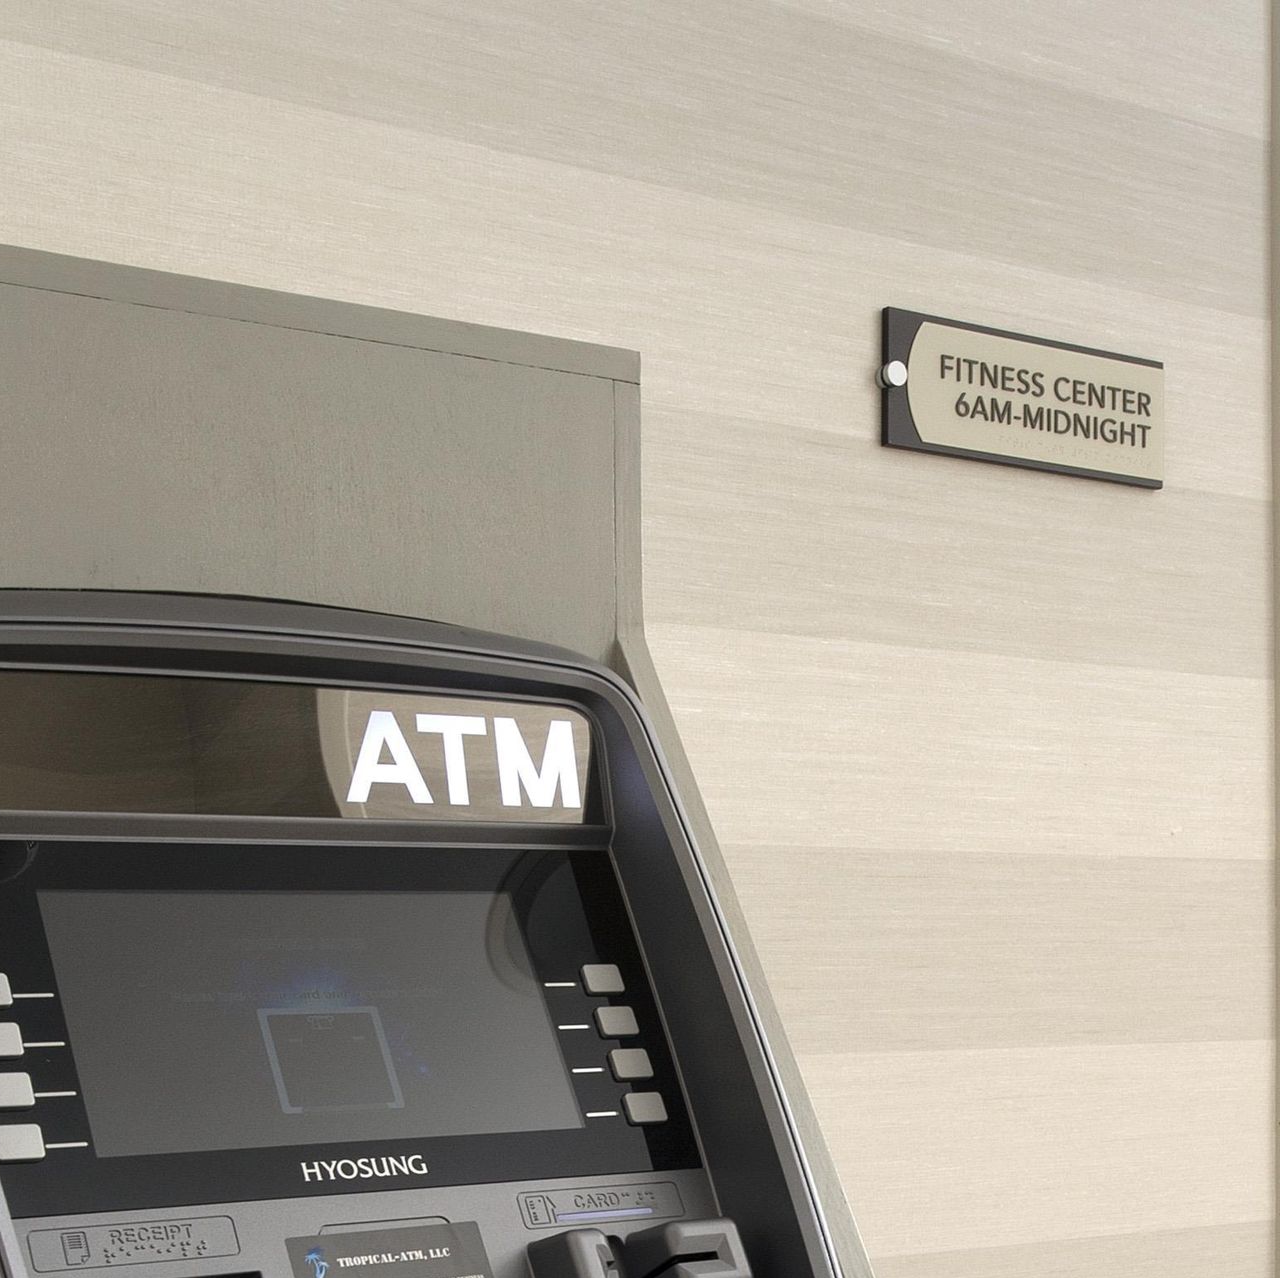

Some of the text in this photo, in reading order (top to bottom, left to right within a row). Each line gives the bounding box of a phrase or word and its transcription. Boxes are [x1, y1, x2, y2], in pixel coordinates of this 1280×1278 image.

[940, 353, 1152, 417] FITNESS CENTER
[954, 391, 1152, 448] 6AM-MIDNIGHT
[346, 710, 581, 809] ATM
[300, 1155, 428, 1182] HYOSUNG
[574, 1192, 620, 1208] CARD
[108, 1223, 192, 1245] RECEIPT
[336, 1247, 451, 1268] TROPICAL-ATM, LLC
